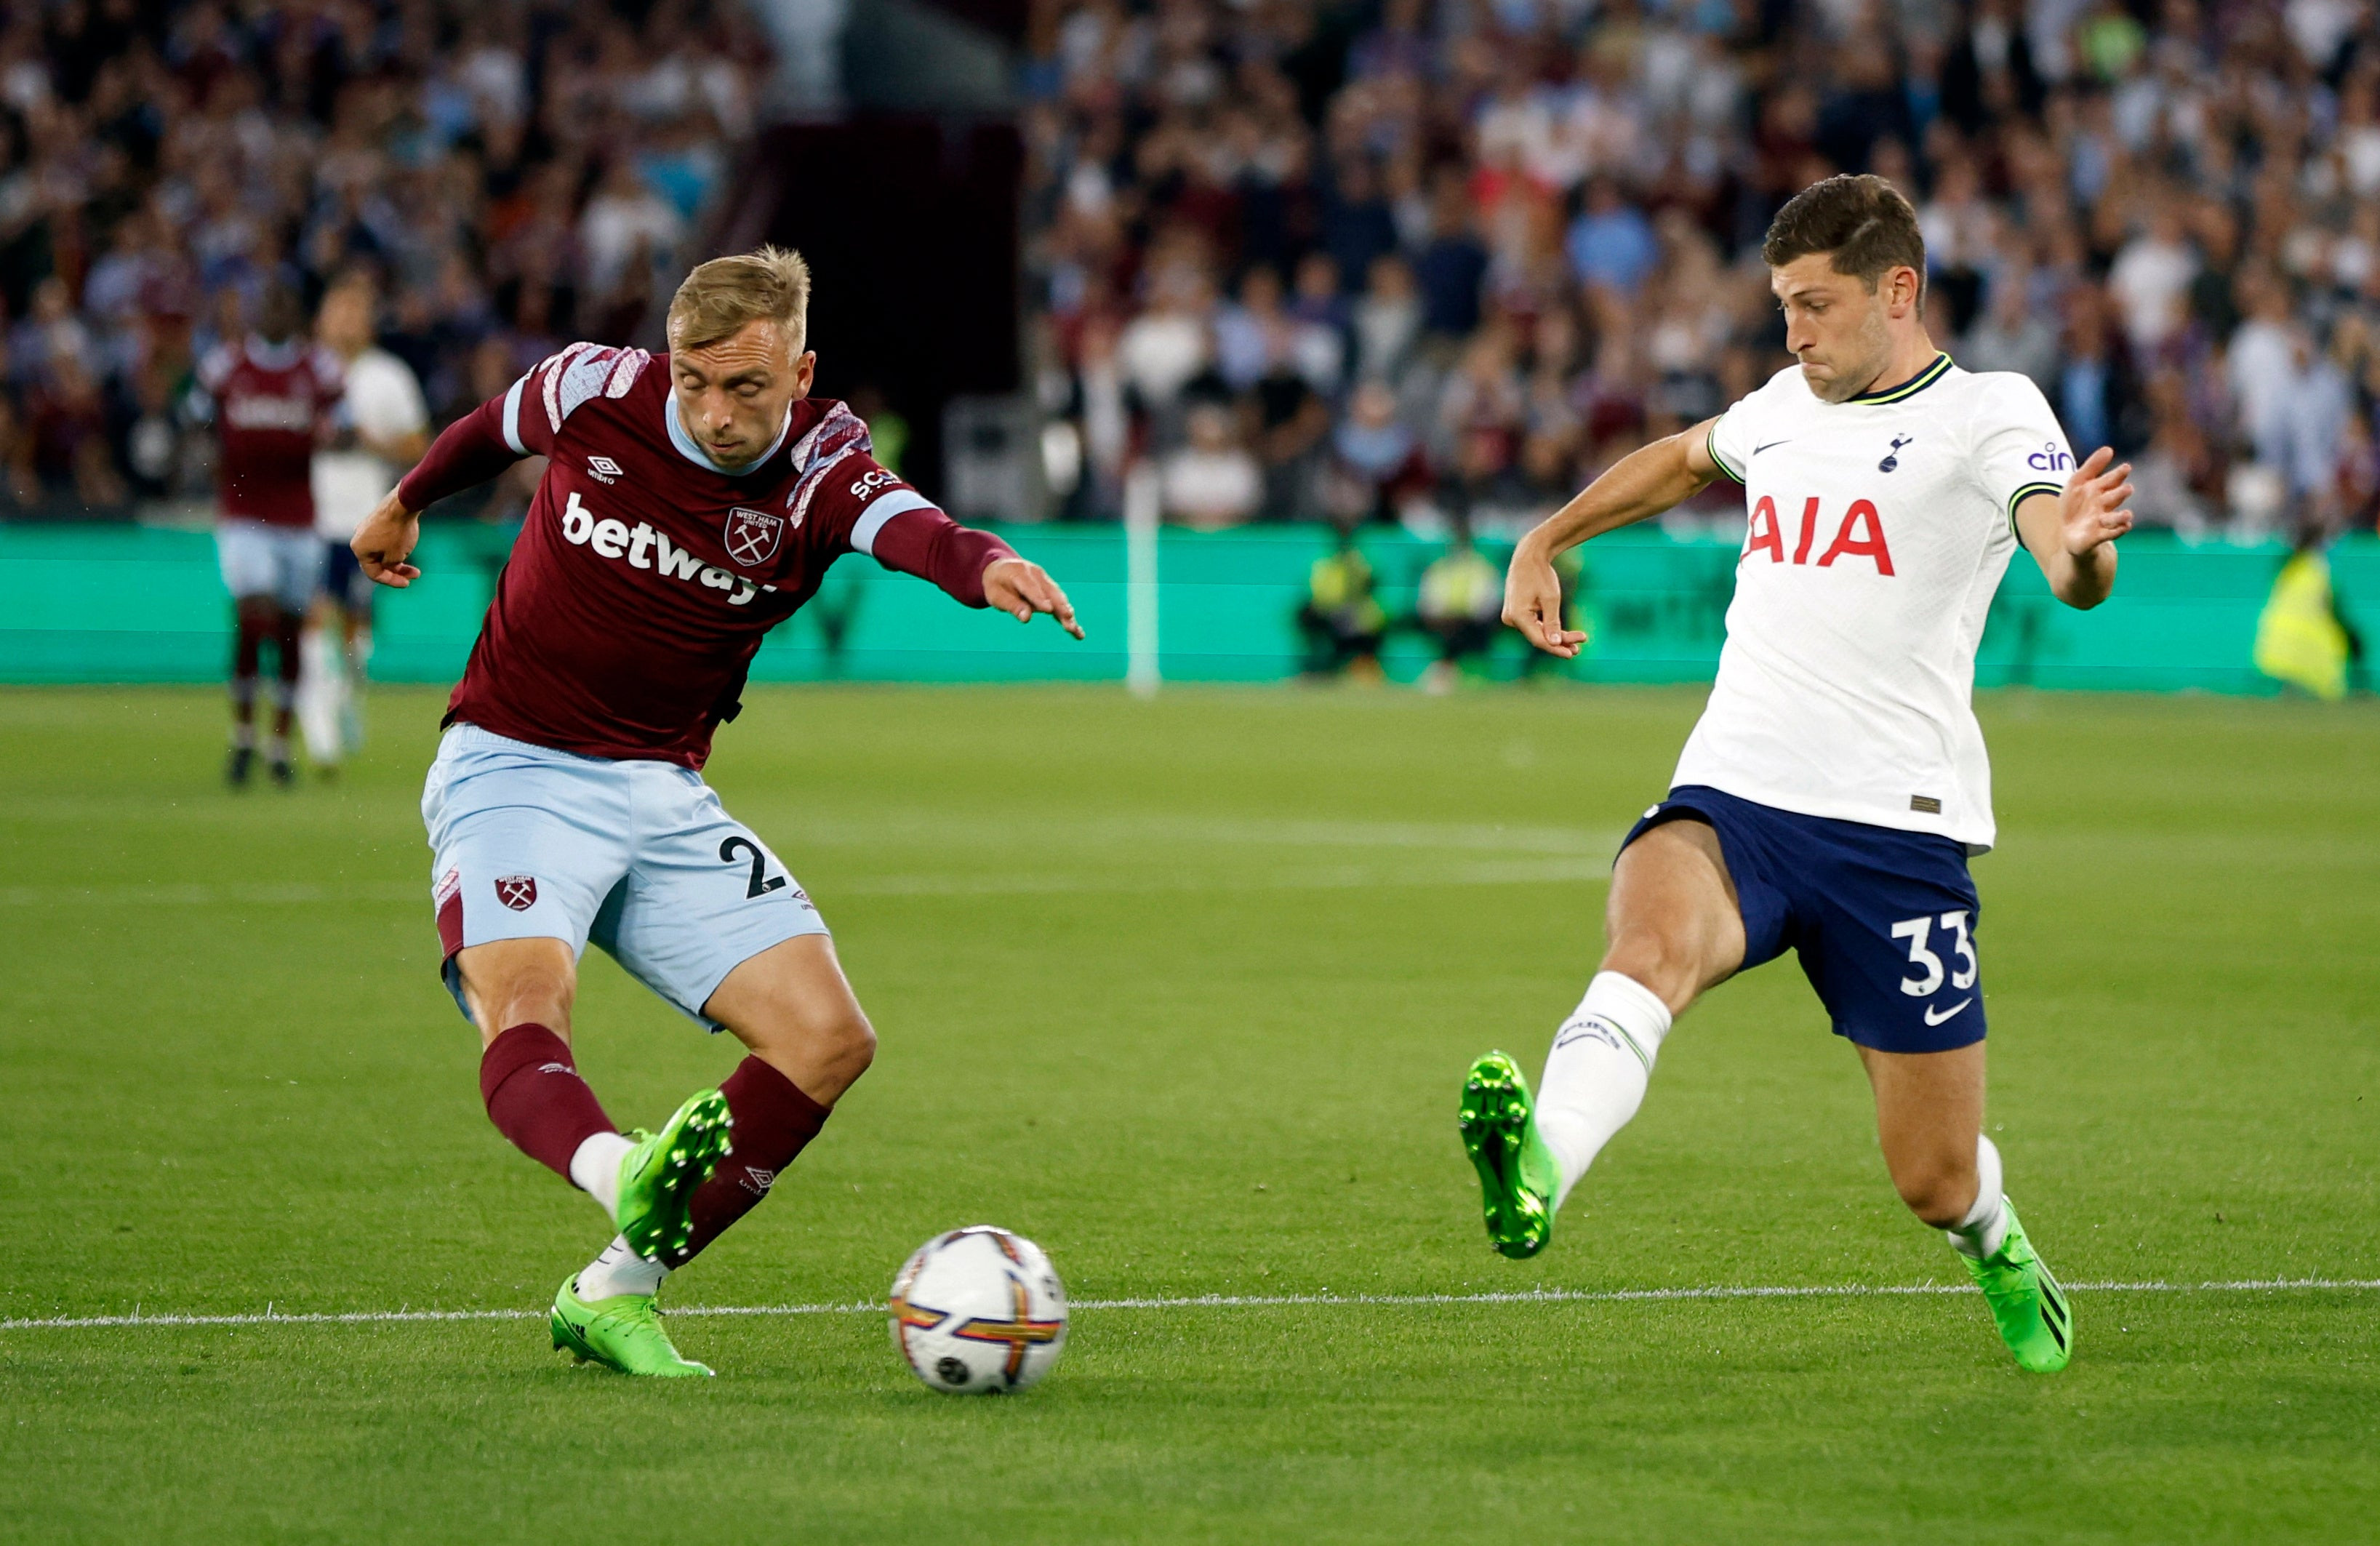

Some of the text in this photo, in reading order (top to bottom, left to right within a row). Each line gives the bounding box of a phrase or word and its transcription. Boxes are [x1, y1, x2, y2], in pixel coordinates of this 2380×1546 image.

[588, 468, 615, 485] umbro
[562, 492, 777, 605] betway
[736, 510, 778, 526] WEST HAM
[743, 518, 768, 529] UNITED
[1740, 495, 1896, 577] AIA
[718, 836, 788, 900] 2
[1891, 910, 1977, 997] 33
